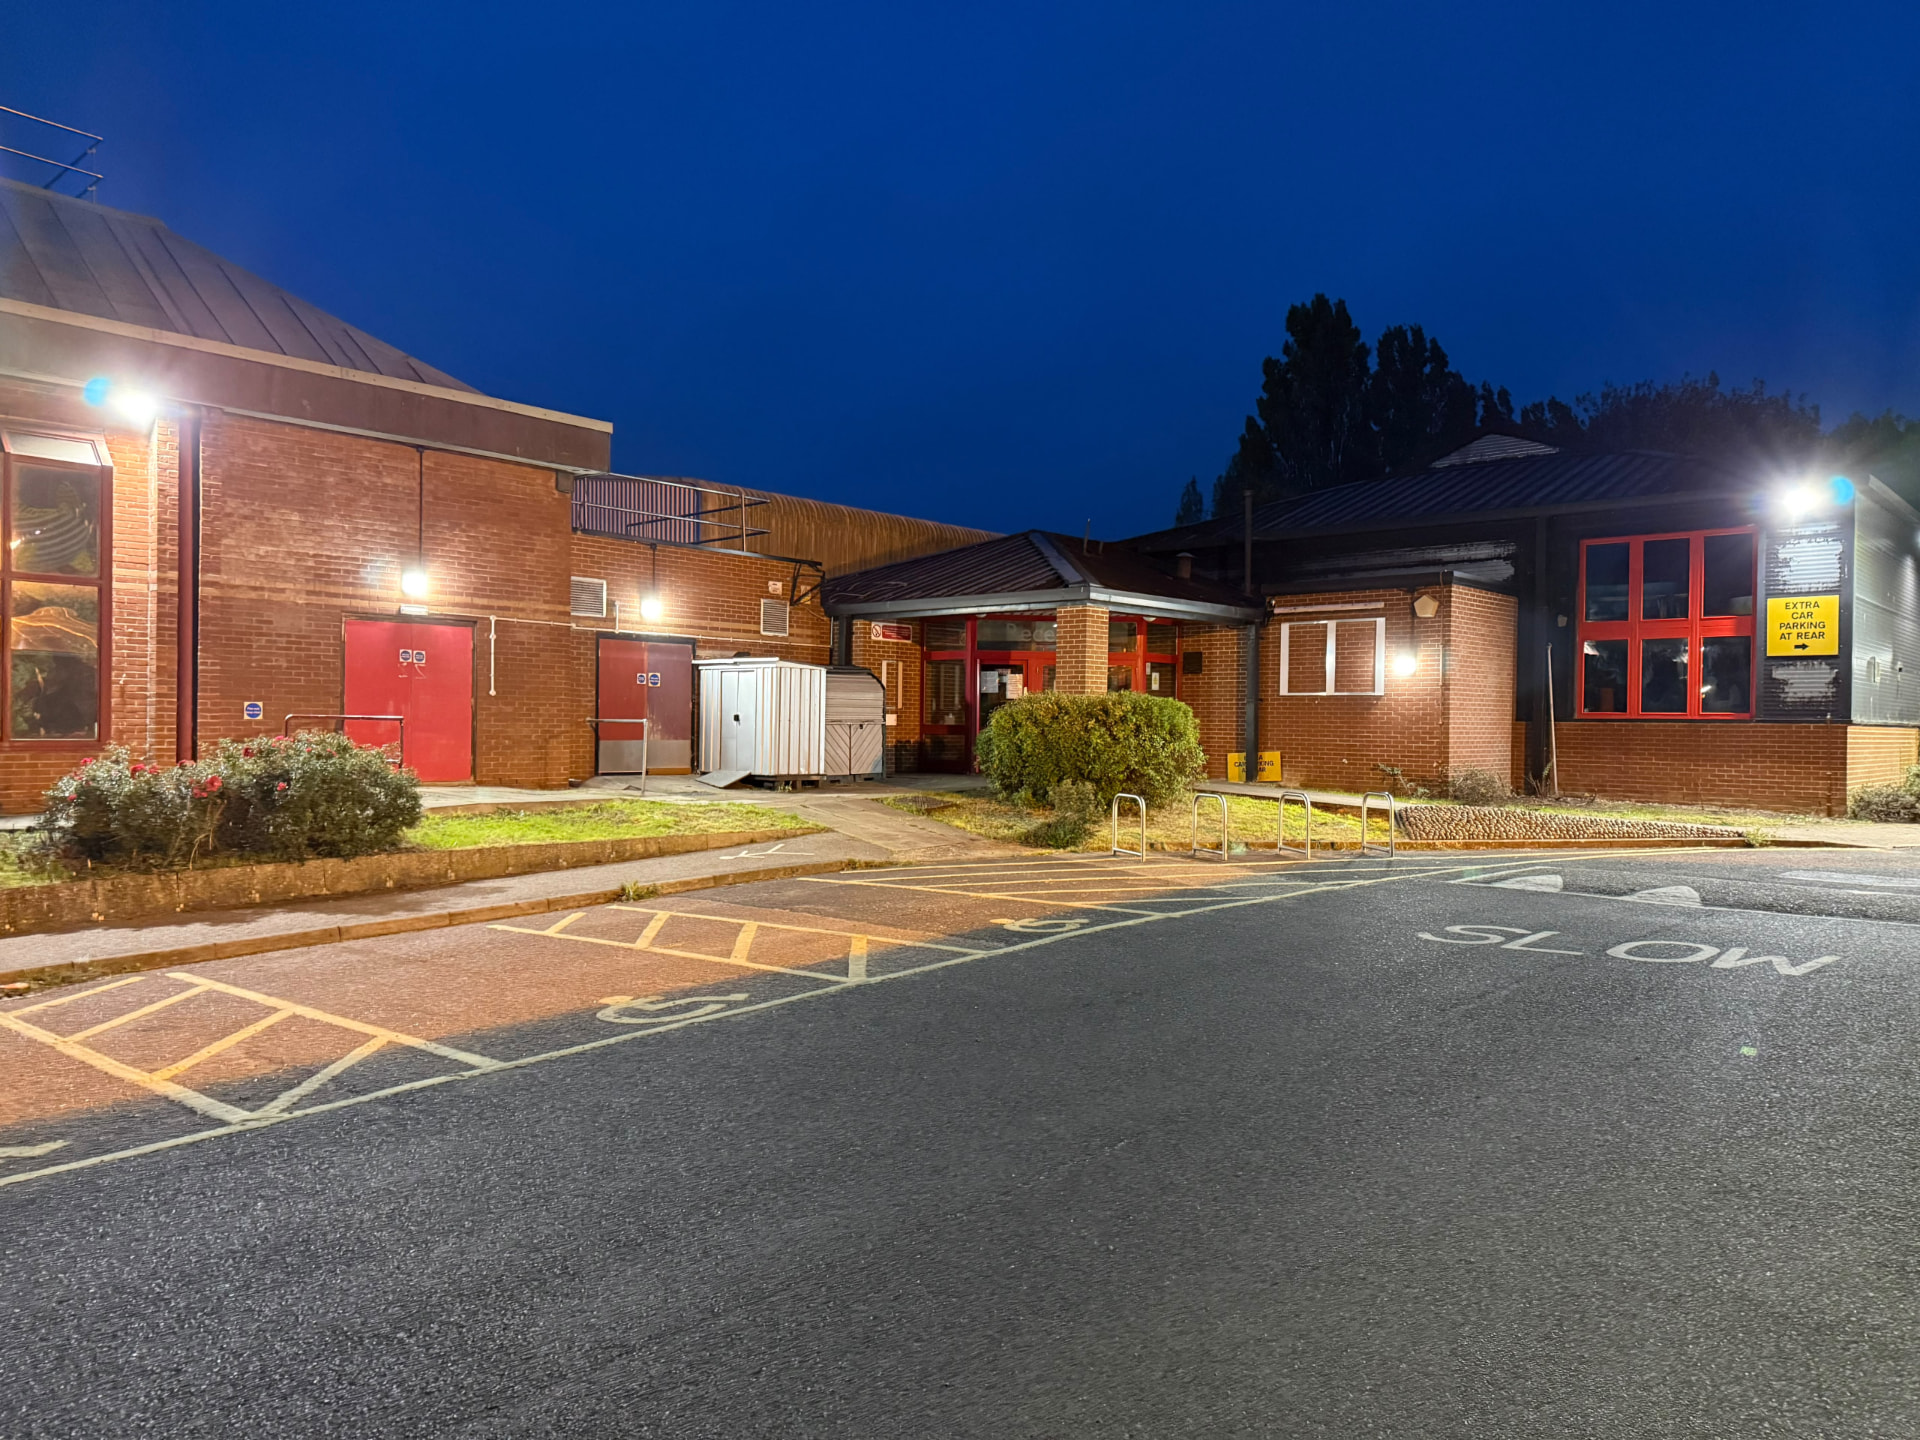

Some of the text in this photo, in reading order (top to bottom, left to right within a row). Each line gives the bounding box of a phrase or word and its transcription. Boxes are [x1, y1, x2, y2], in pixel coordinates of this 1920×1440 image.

[1785, 601, 1820, 610] EXTRA
[1791, 611, 1814, 620] CAR
[1779, 621, 1826, 630] PARKING
[1779, 631, 1825, 640] AT REAR
[1417, 924, 1841, 976] SLOW
